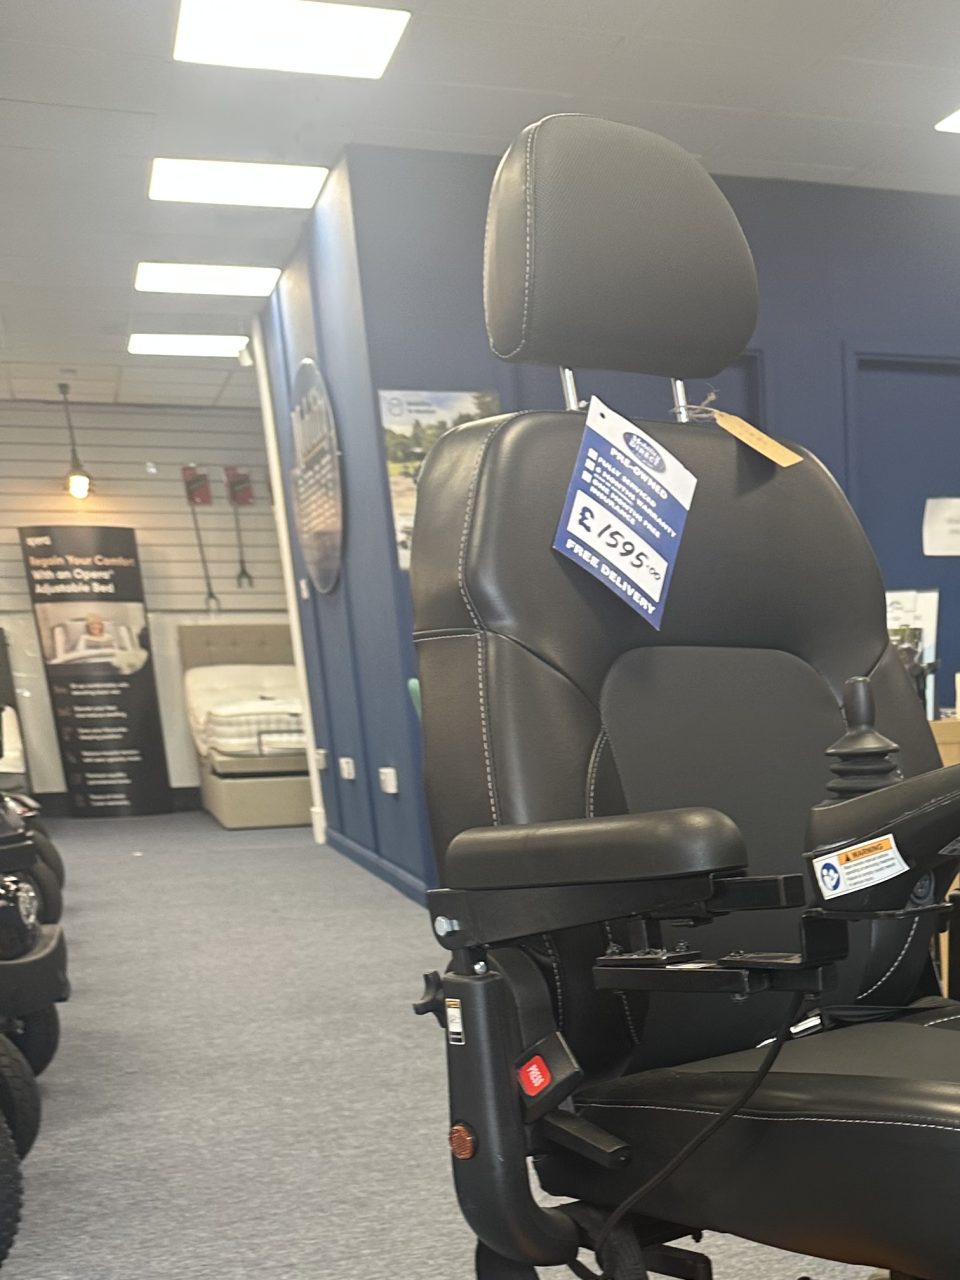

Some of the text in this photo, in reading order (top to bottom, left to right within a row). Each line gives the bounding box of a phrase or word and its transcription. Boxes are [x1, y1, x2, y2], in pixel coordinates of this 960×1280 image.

[610, 446, 667, 501] PRE-OWNED
[635, 498, 676, 539] WARRANTY
[35, 582, 116, 596] Adjustable Bed
[565, 537, 656, 615] FREE DELIVERY
